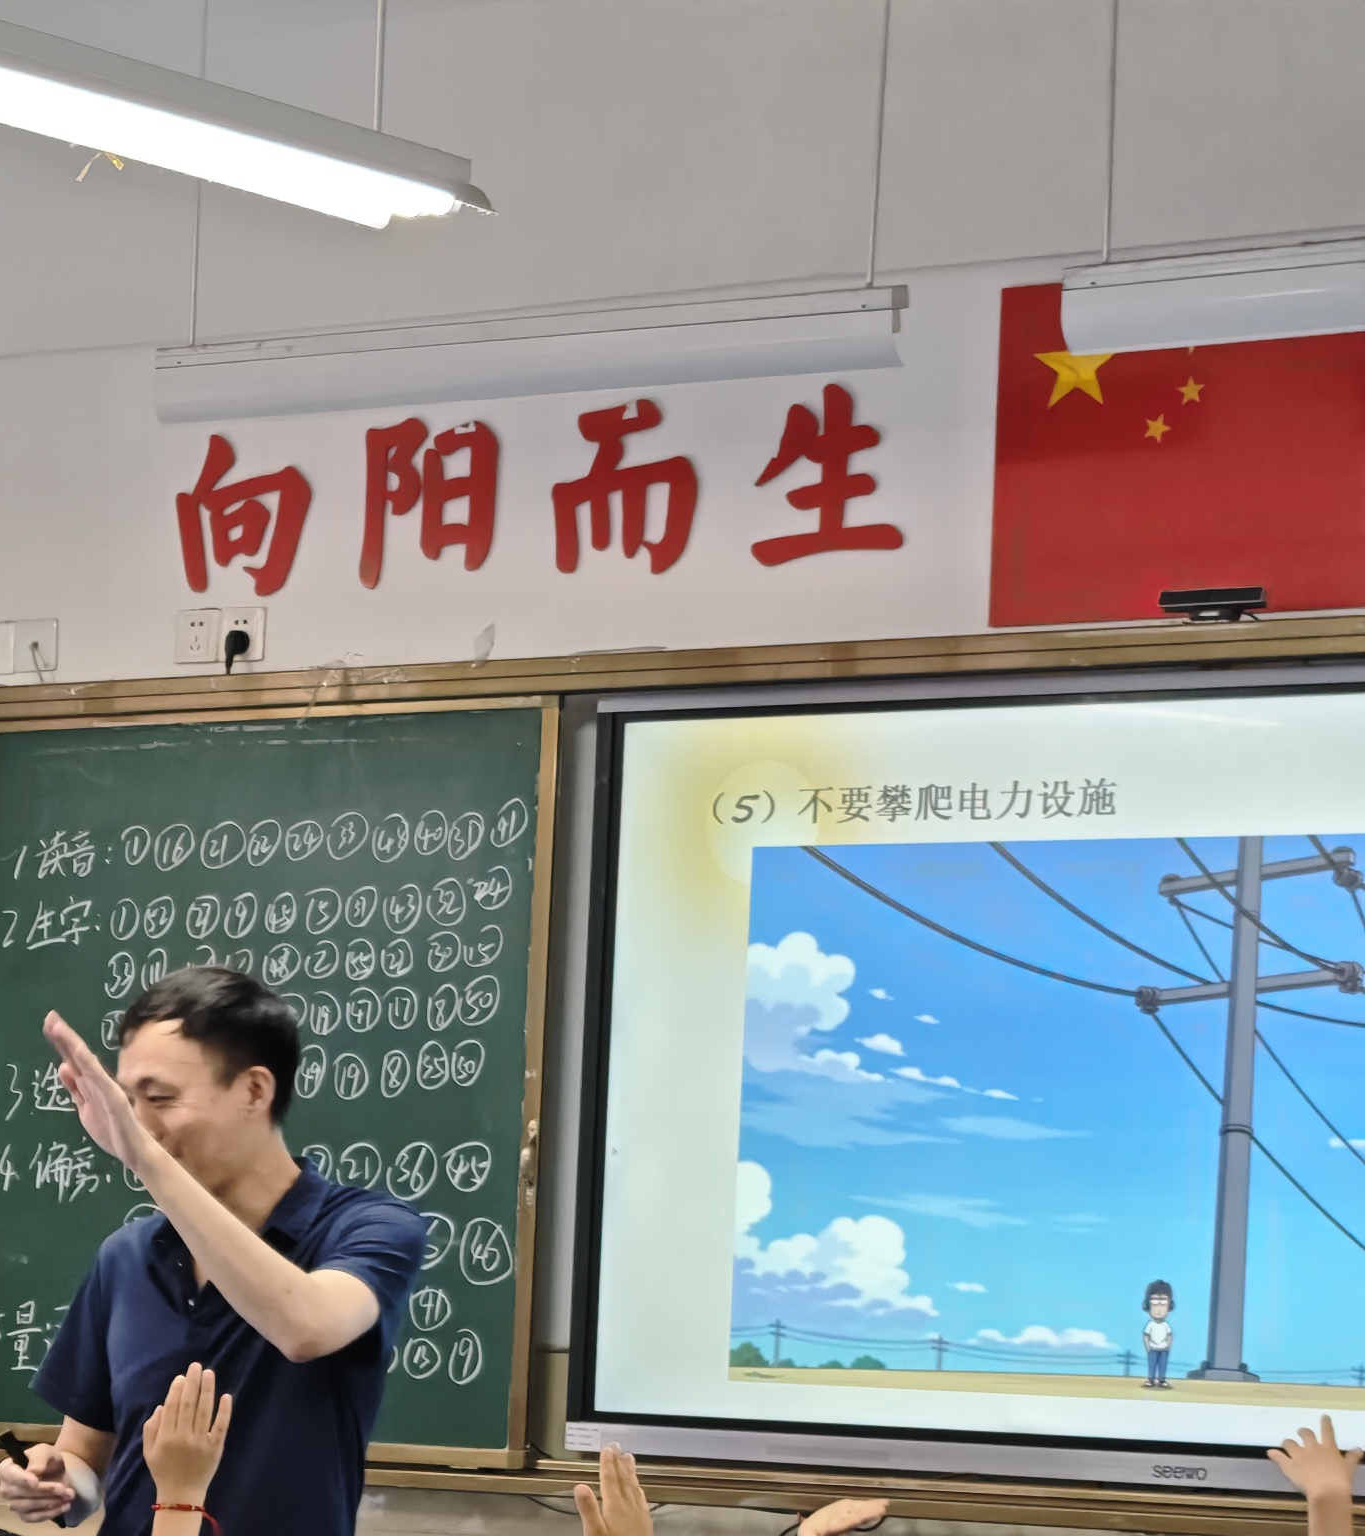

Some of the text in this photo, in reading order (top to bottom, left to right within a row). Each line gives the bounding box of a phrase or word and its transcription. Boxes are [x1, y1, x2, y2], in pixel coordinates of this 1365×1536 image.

[174, 383, 905, 597] 向阳而生
[1152, 1465, 1207, 1480] seewo
